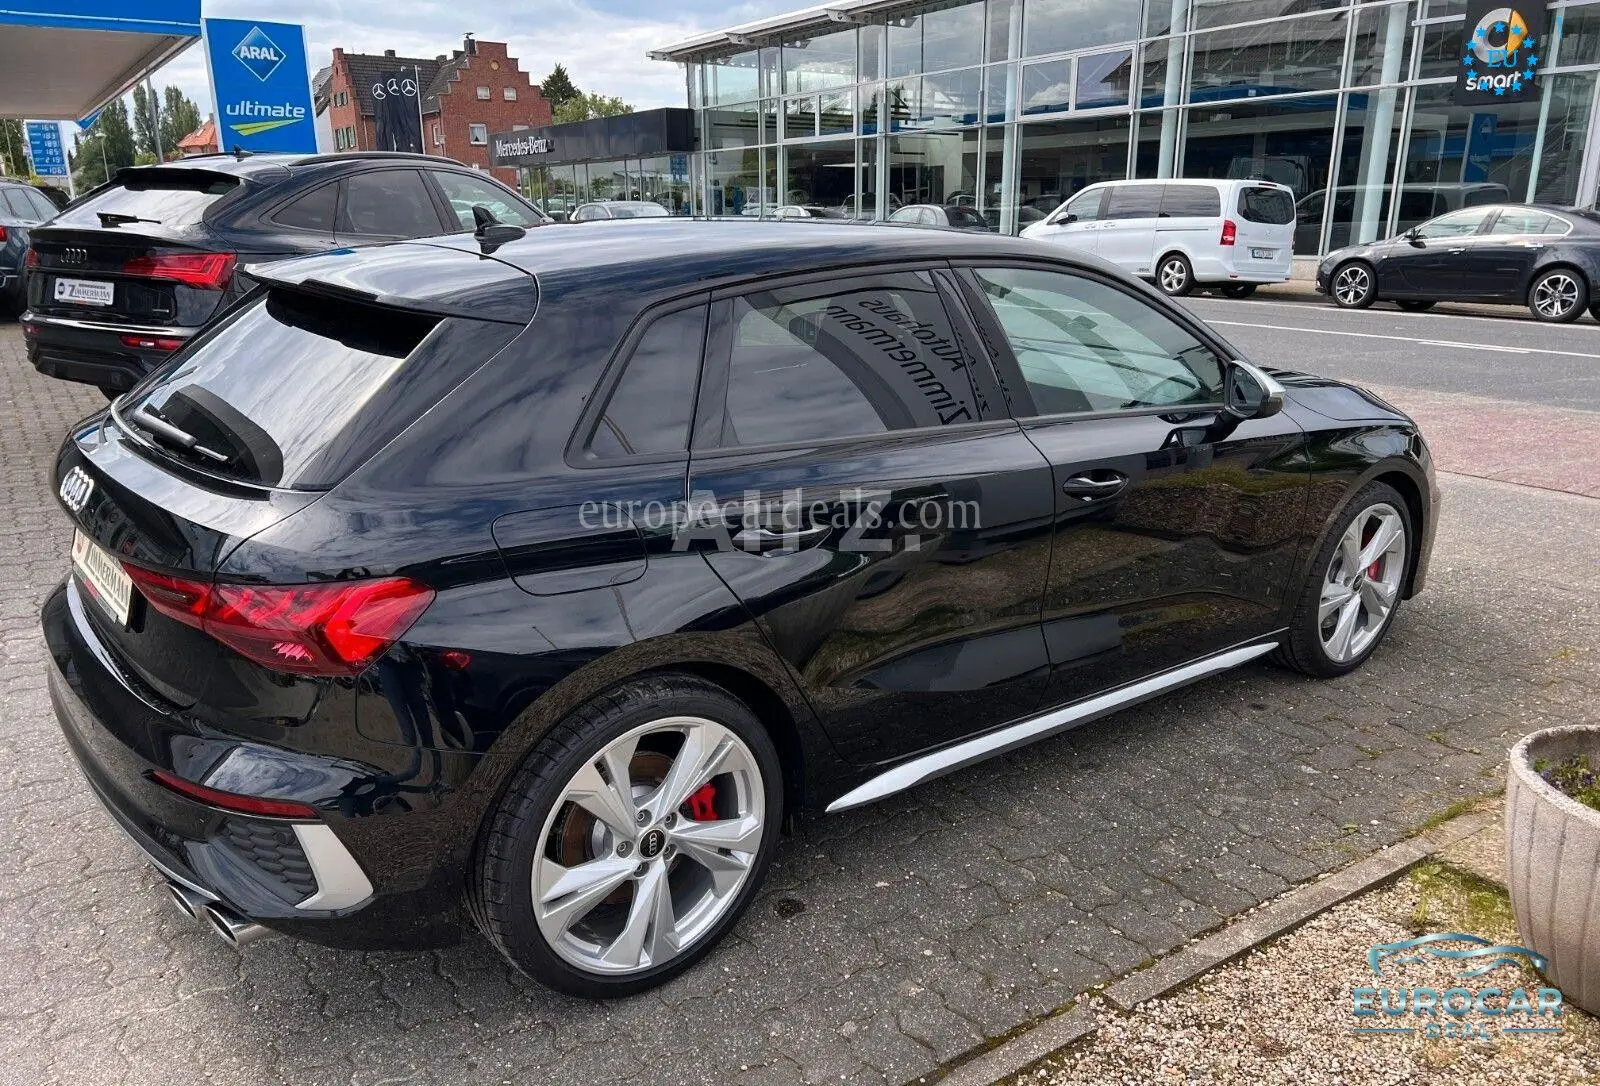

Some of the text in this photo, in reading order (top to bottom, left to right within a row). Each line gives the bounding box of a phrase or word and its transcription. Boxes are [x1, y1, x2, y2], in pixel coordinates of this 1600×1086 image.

[240, 45, 279, 61] ARAL
[1465, 70, 1522, 91] smart
[226, 100, 305, 118] ultimate
[495, 136, 548, 157] Mercedes-Benz
